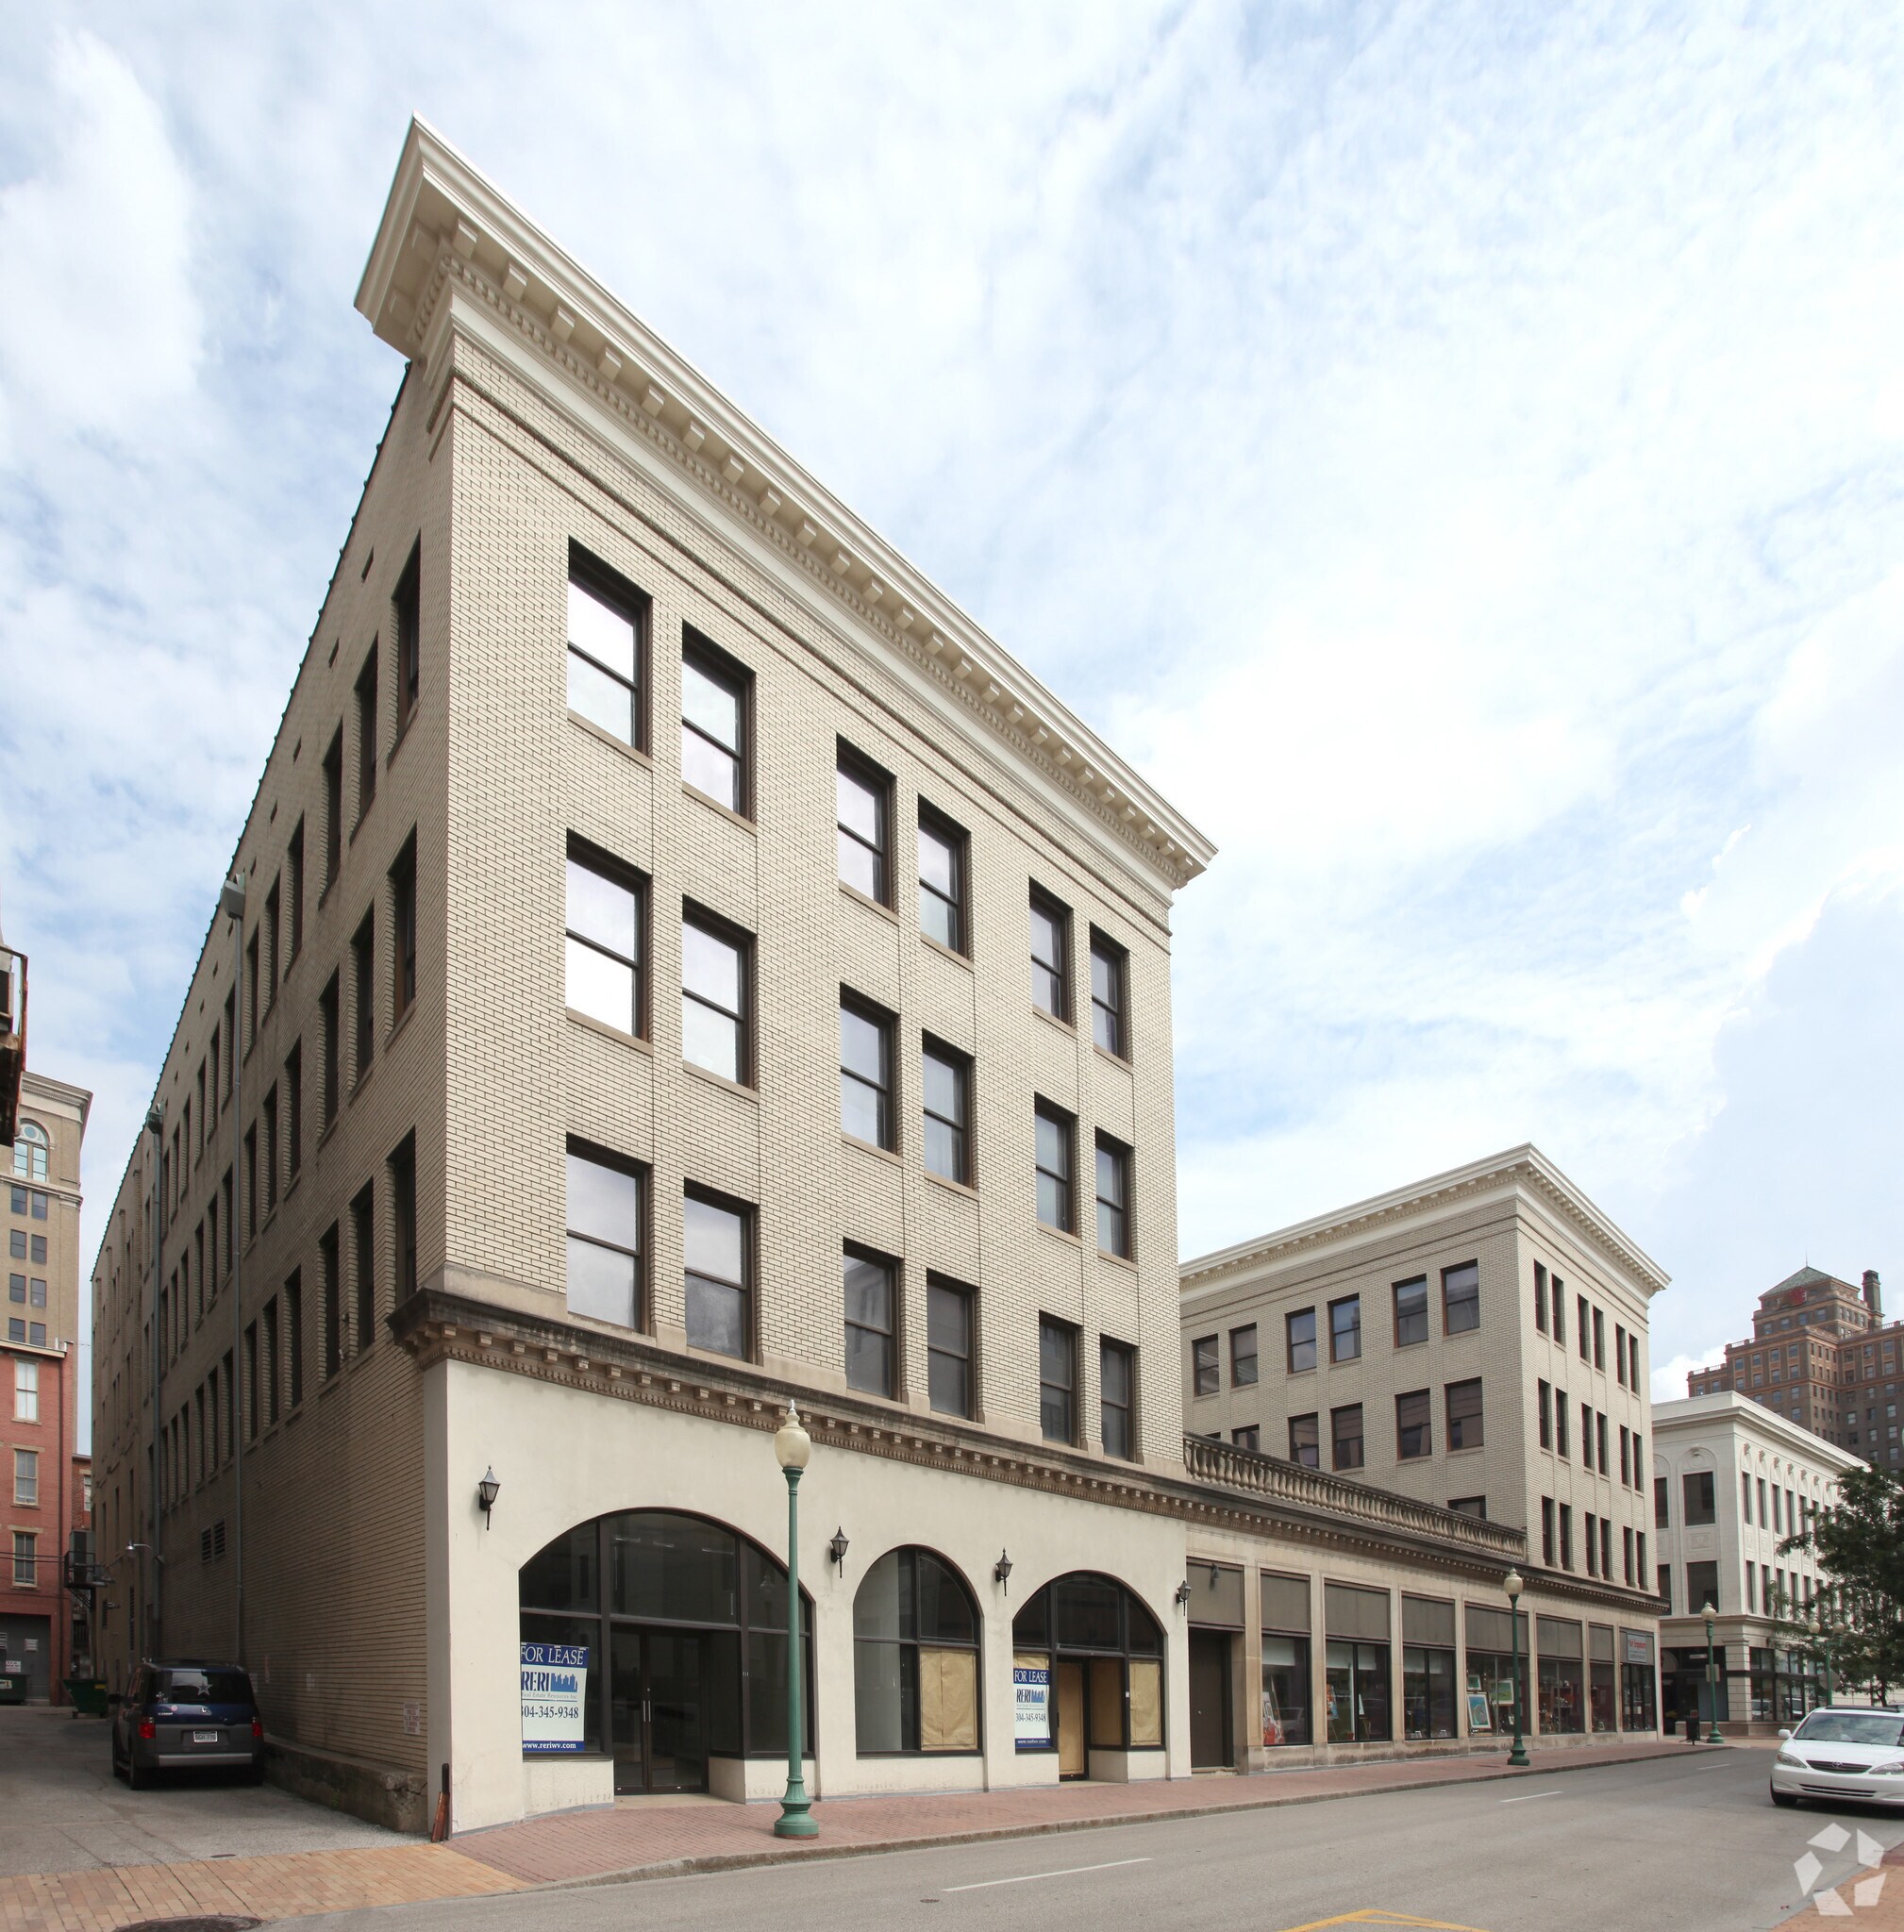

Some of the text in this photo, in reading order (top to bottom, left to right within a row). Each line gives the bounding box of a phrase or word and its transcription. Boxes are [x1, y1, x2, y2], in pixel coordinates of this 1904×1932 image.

[521, 1645, 584, 1665] FOR LEASE
[522, 1671, 549, 1691] RERI
[1014, 1670, 1047, 1683] FOR LEASE
[1016, 1689, 1030, 1703] RERI
[1016, 1712, 1046, 1723] 304-345-9348
